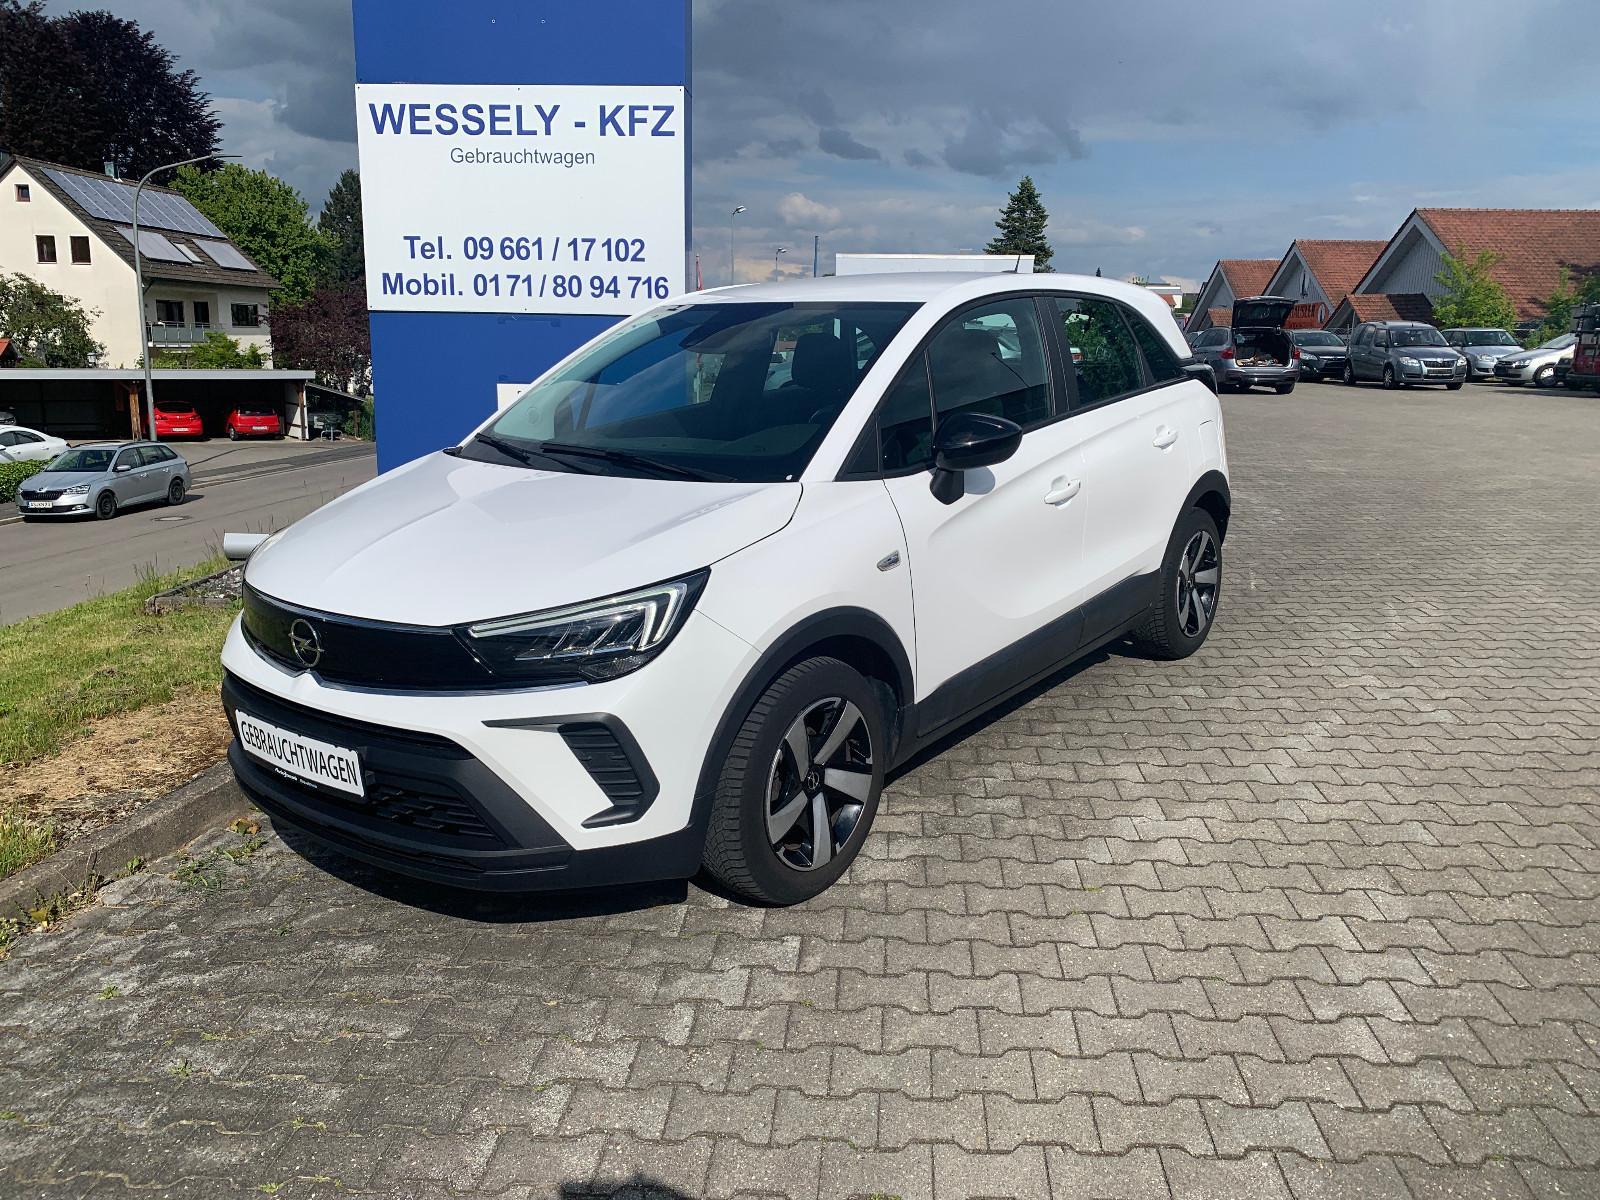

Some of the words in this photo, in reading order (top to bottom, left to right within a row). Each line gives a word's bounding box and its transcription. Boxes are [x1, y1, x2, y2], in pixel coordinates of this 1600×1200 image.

[368, 103, 560, 136] WESSELY
[599, 104, 676, 137] KFZ
[450, 147, 595, 168] Gebrauchtwagen
[403, 235, 452, 260] Tel.
[381, 272, 463, 296] Mobil.
[627, 275, 669, 300] 716
[241, 720, 358, 787] GEBRAUCHTWAGEN
